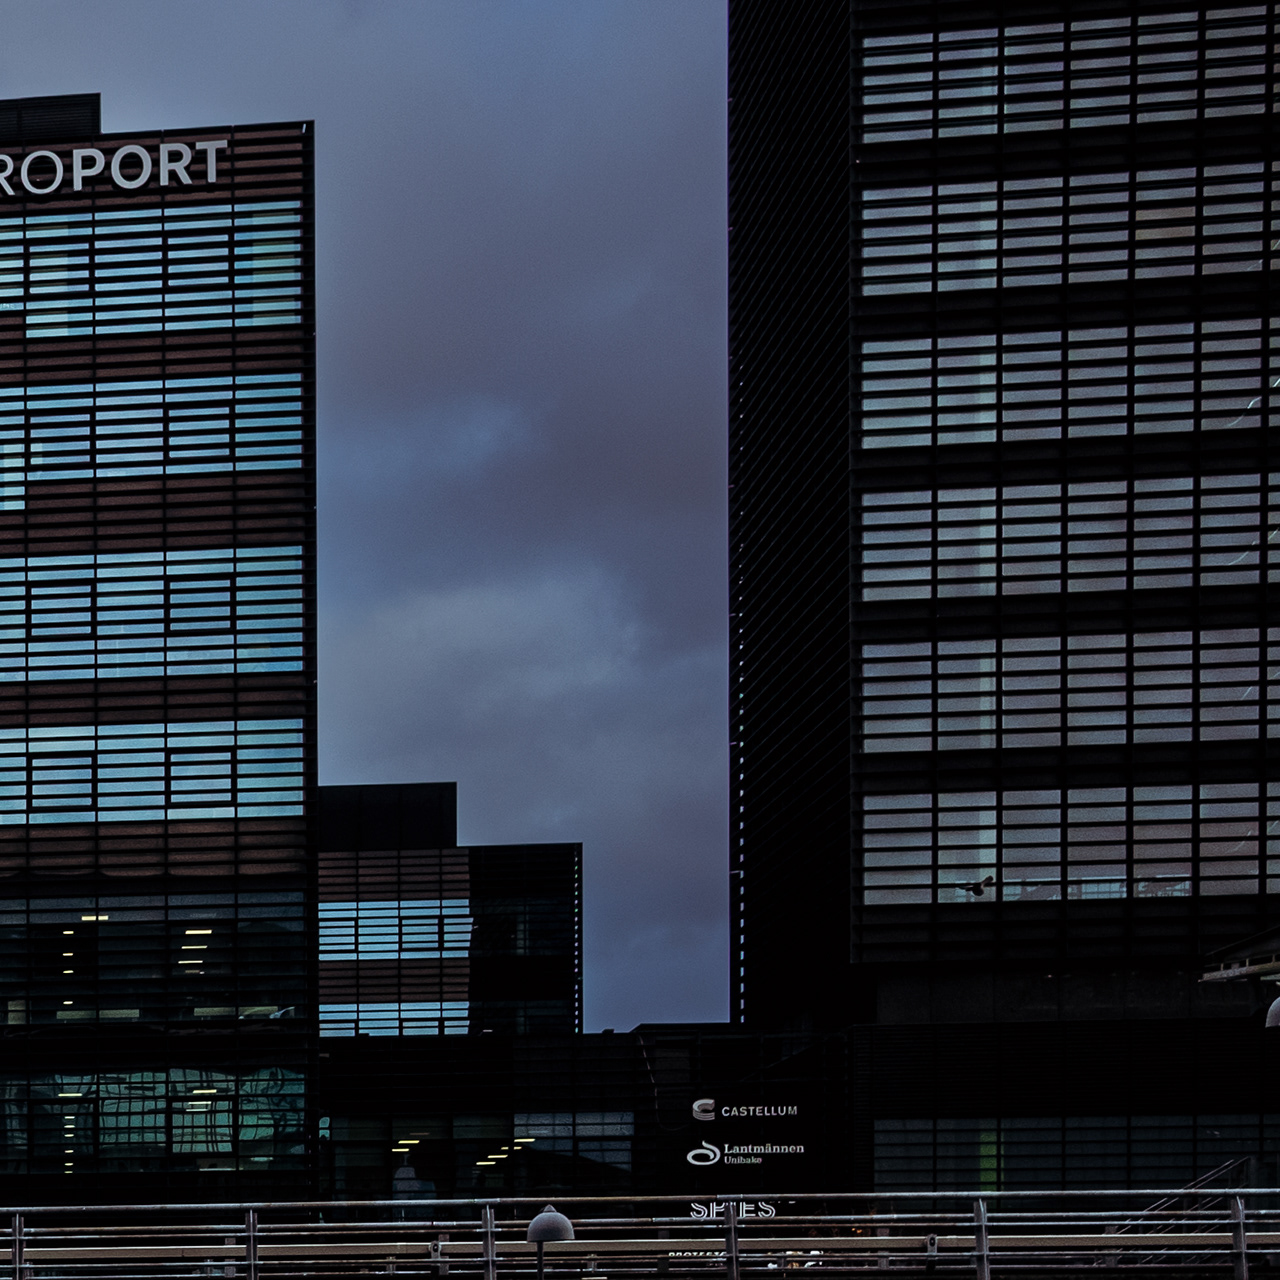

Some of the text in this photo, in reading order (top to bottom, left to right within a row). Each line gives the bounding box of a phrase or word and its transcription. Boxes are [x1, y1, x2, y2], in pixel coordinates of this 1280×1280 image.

[721, 1105, 798, 1117] CASTELLUM
[724, 1143, 805, 1154] Lantmännen
[690, 1201, 776, 1218] SPES
